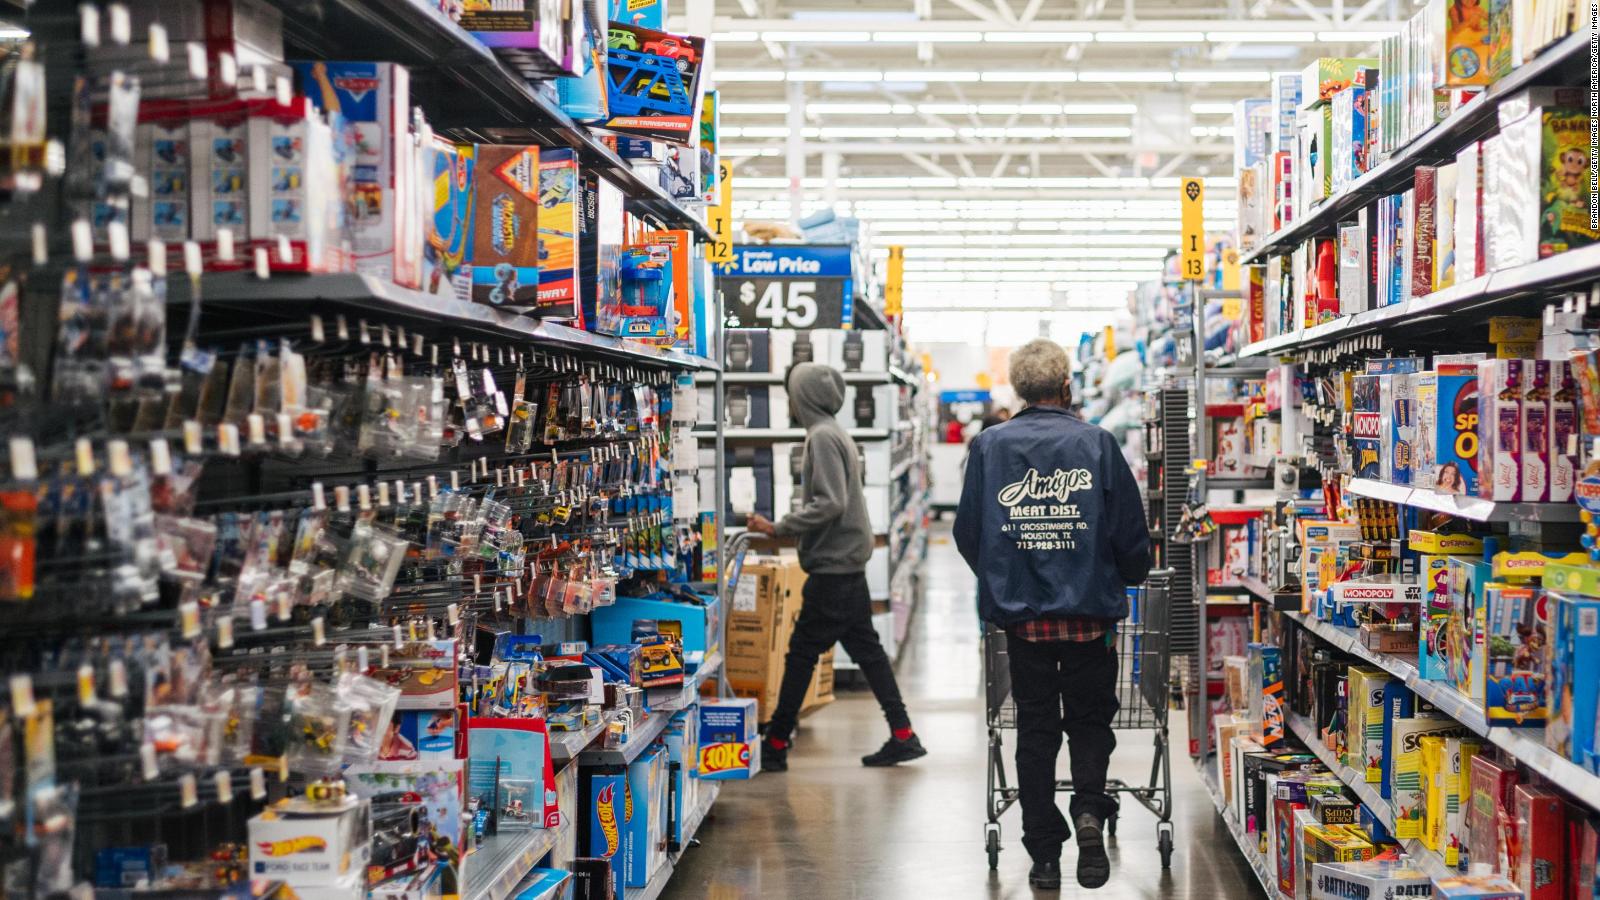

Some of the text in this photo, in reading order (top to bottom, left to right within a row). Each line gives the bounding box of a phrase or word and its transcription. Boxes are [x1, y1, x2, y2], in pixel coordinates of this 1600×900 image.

[587, 190, 596, 220] NASCAR
[716, 218, 722, 235] I
[710, 242, 727, 258] 12
[1191, 235, 1197, 251] I
[743, 255, 820, 273] Low Price
[1187, 260, 1202, 275] 13
[998, 468, 1092, 506] Amigos
[1010, 504, 1080, 517] MEAT DIST.
[1001, 522, 1089, 531] 611 CROSSTIMBERS RD.
[1063, 531, 1071, 539] TX
[1016, 541, 1075, 550] 713-928-3111
[1344, 589, 1393, 598] MONOPOLY
[1325, 808, 1353, 818] CHIPS
[1324, 875, 1370, 900] BATTLESHIP
